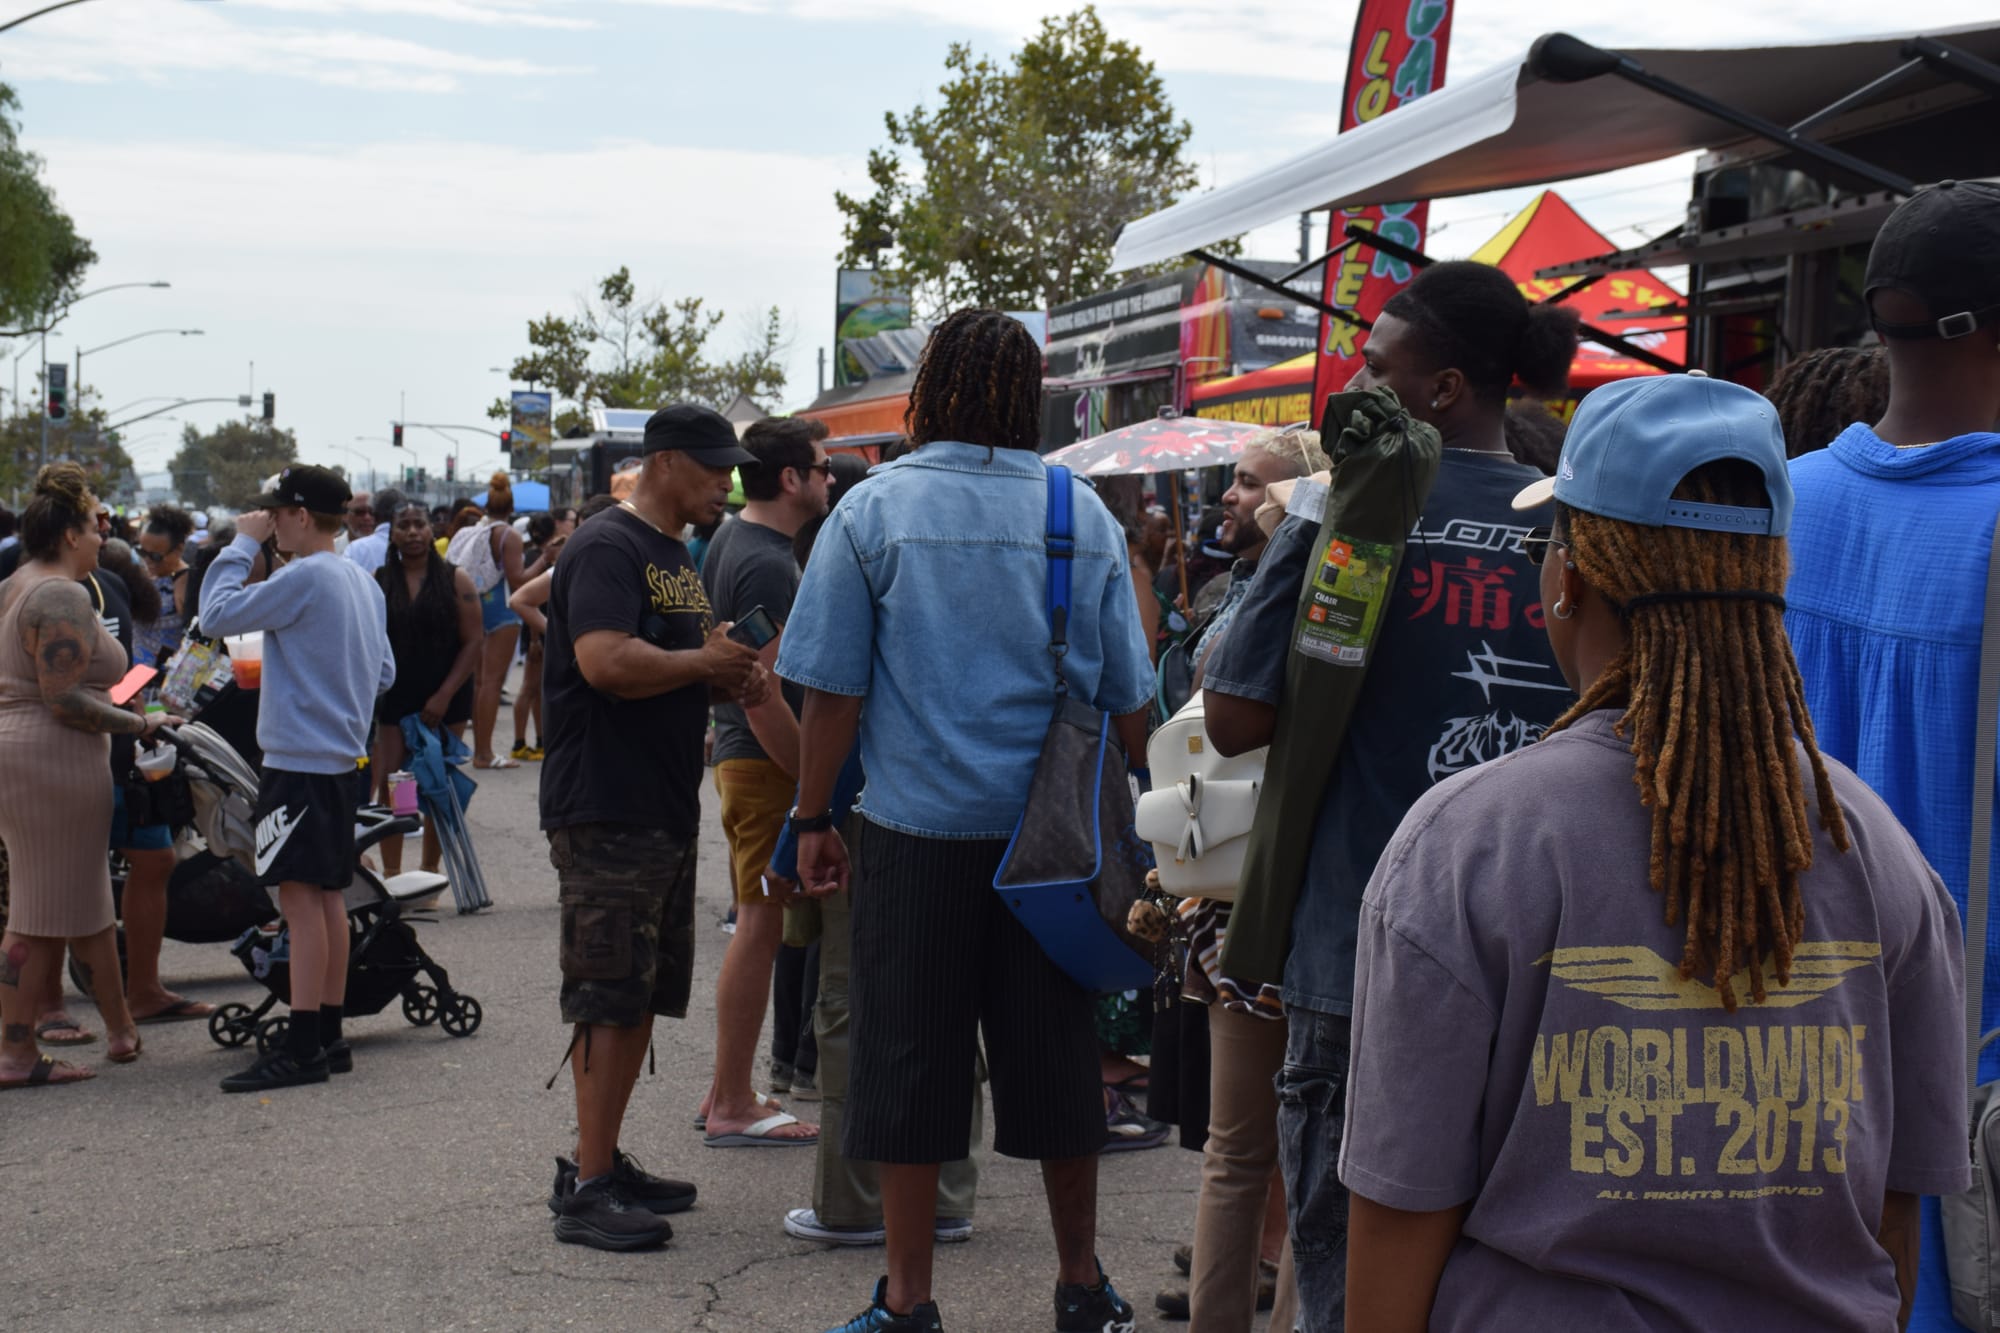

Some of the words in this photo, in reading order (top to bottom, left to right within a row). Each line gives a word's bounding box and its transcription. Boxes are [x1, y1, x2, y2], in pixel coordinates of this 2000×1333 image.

[1315, 592, 1338, 606] CHAIR
[255, 804, 291, 854] NIKE
[1533, 1025, 1867, 1106] WORLDWIDE
[1570, 1098, 1696, 1178] EST.
[1715, 1100, 1849, 1175] 2013
[1597, 1189, 1638, 1200] ALL
[1644, 1190, 1724, 1200] RIGHTS
[1728, 1186, 1824, 1200] RESERVED
